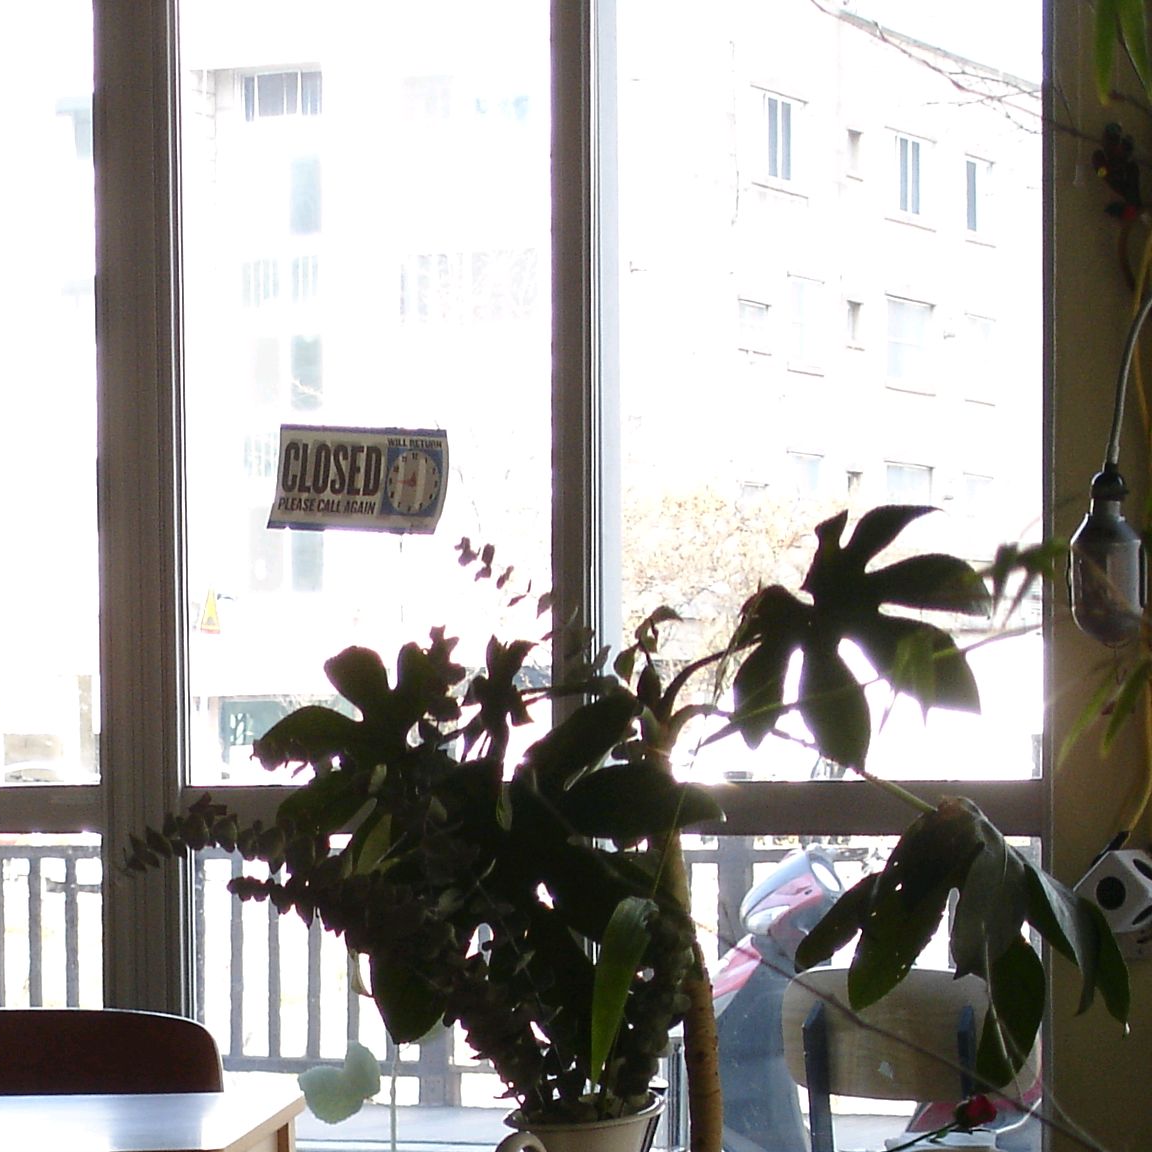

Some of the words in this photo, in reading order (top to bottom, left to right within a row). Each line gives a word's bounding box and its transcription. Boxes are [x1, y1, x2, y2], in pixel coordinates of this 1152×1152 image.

[387, 438, 406, 448] WILL
[409, 438, 442, 449] RETURN
[282, 441, 382, 497] CLOSED
[278, 497, 315, 512] PLEASE
[317, 499, 342, 514] CALL
[344, 501, 376, 515] AGAIN
